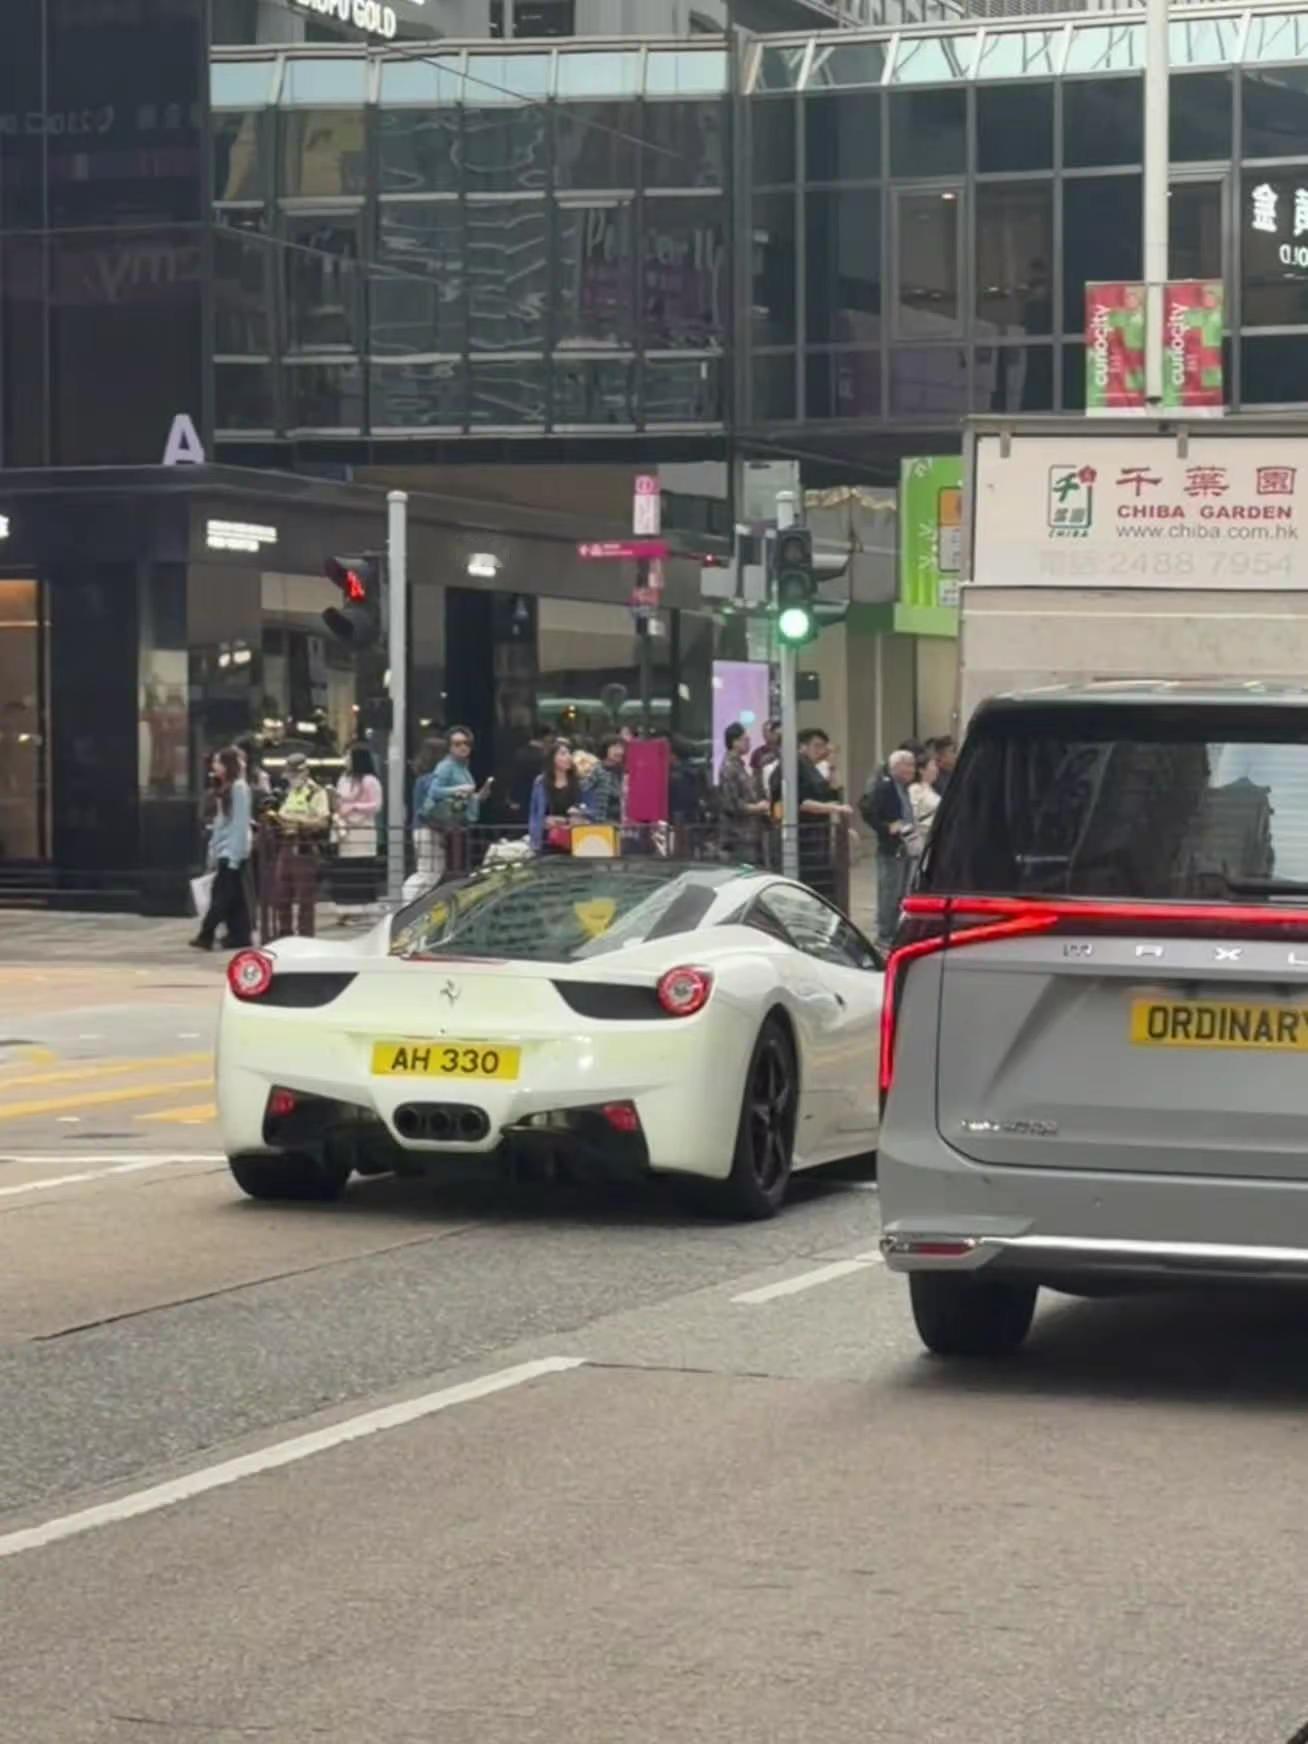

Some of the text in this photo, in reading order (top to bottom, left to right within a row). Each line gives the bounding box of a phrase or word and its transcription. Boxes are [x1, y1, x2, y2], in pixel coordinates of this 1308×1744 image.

[353, 0, 397, 38] GOLD
[1117, 505, 1293, 520] CHIBA GARDEN
[1116, 523, 1299, 539] www.chiba.com.hk
[1108, 551, 1194, 576] 2488
[1208, 551, 1292, 576] 7954
[391, 1047, 500, 1075] AH 330
